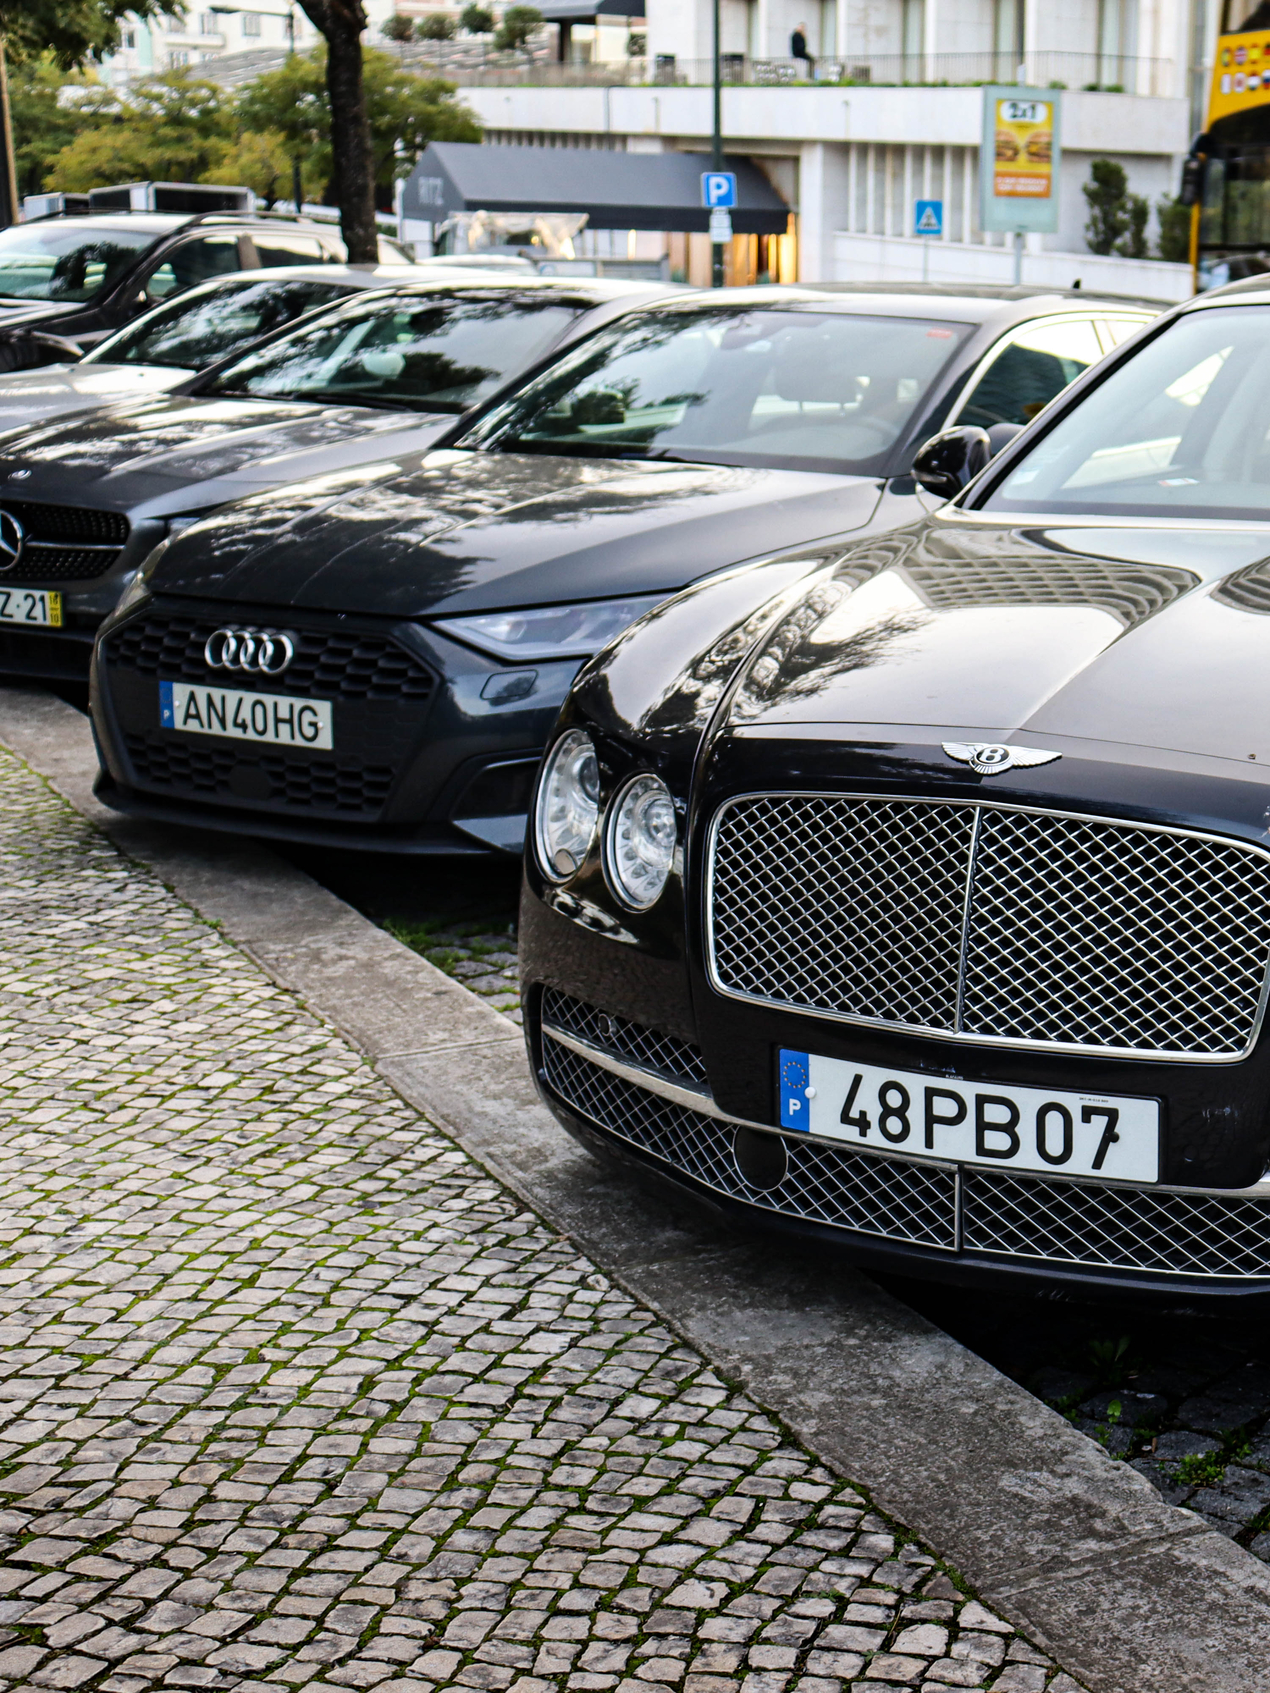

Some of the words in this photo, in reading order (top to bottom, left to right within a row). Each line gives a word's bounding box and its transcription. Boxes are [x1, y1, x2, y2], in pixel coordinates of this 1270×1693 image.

[709, 175, 730, 205] P
[182, 690, 319, 743] AN40HG
[789, 1098, 801, 1116] P
[840, 1073, 1119, 1170] 48PB07
